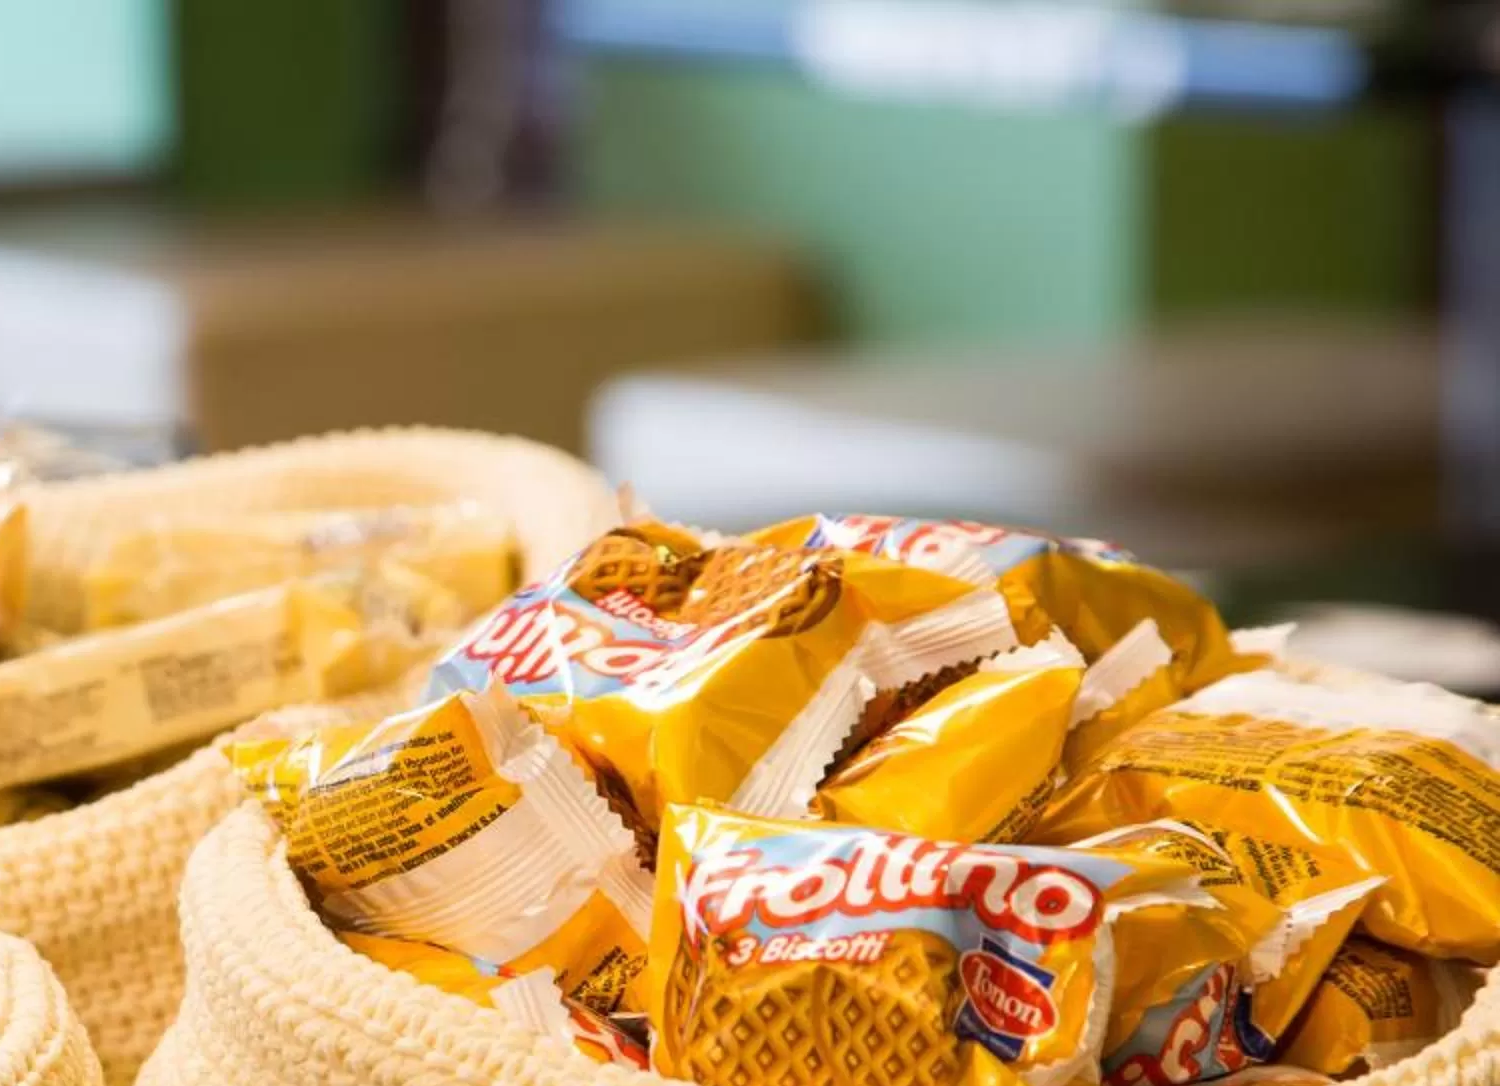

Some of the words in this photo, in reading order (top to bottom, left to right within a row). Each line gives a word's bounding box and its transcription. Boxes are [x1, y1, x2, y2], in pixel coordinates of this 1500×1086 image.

[690, 830, 1098, 937] Frollino
[728, 938, 754, 966] 3
[759, 931, 891, 964] Biscotti
[971, 955, 1043, 1029] Tonon
